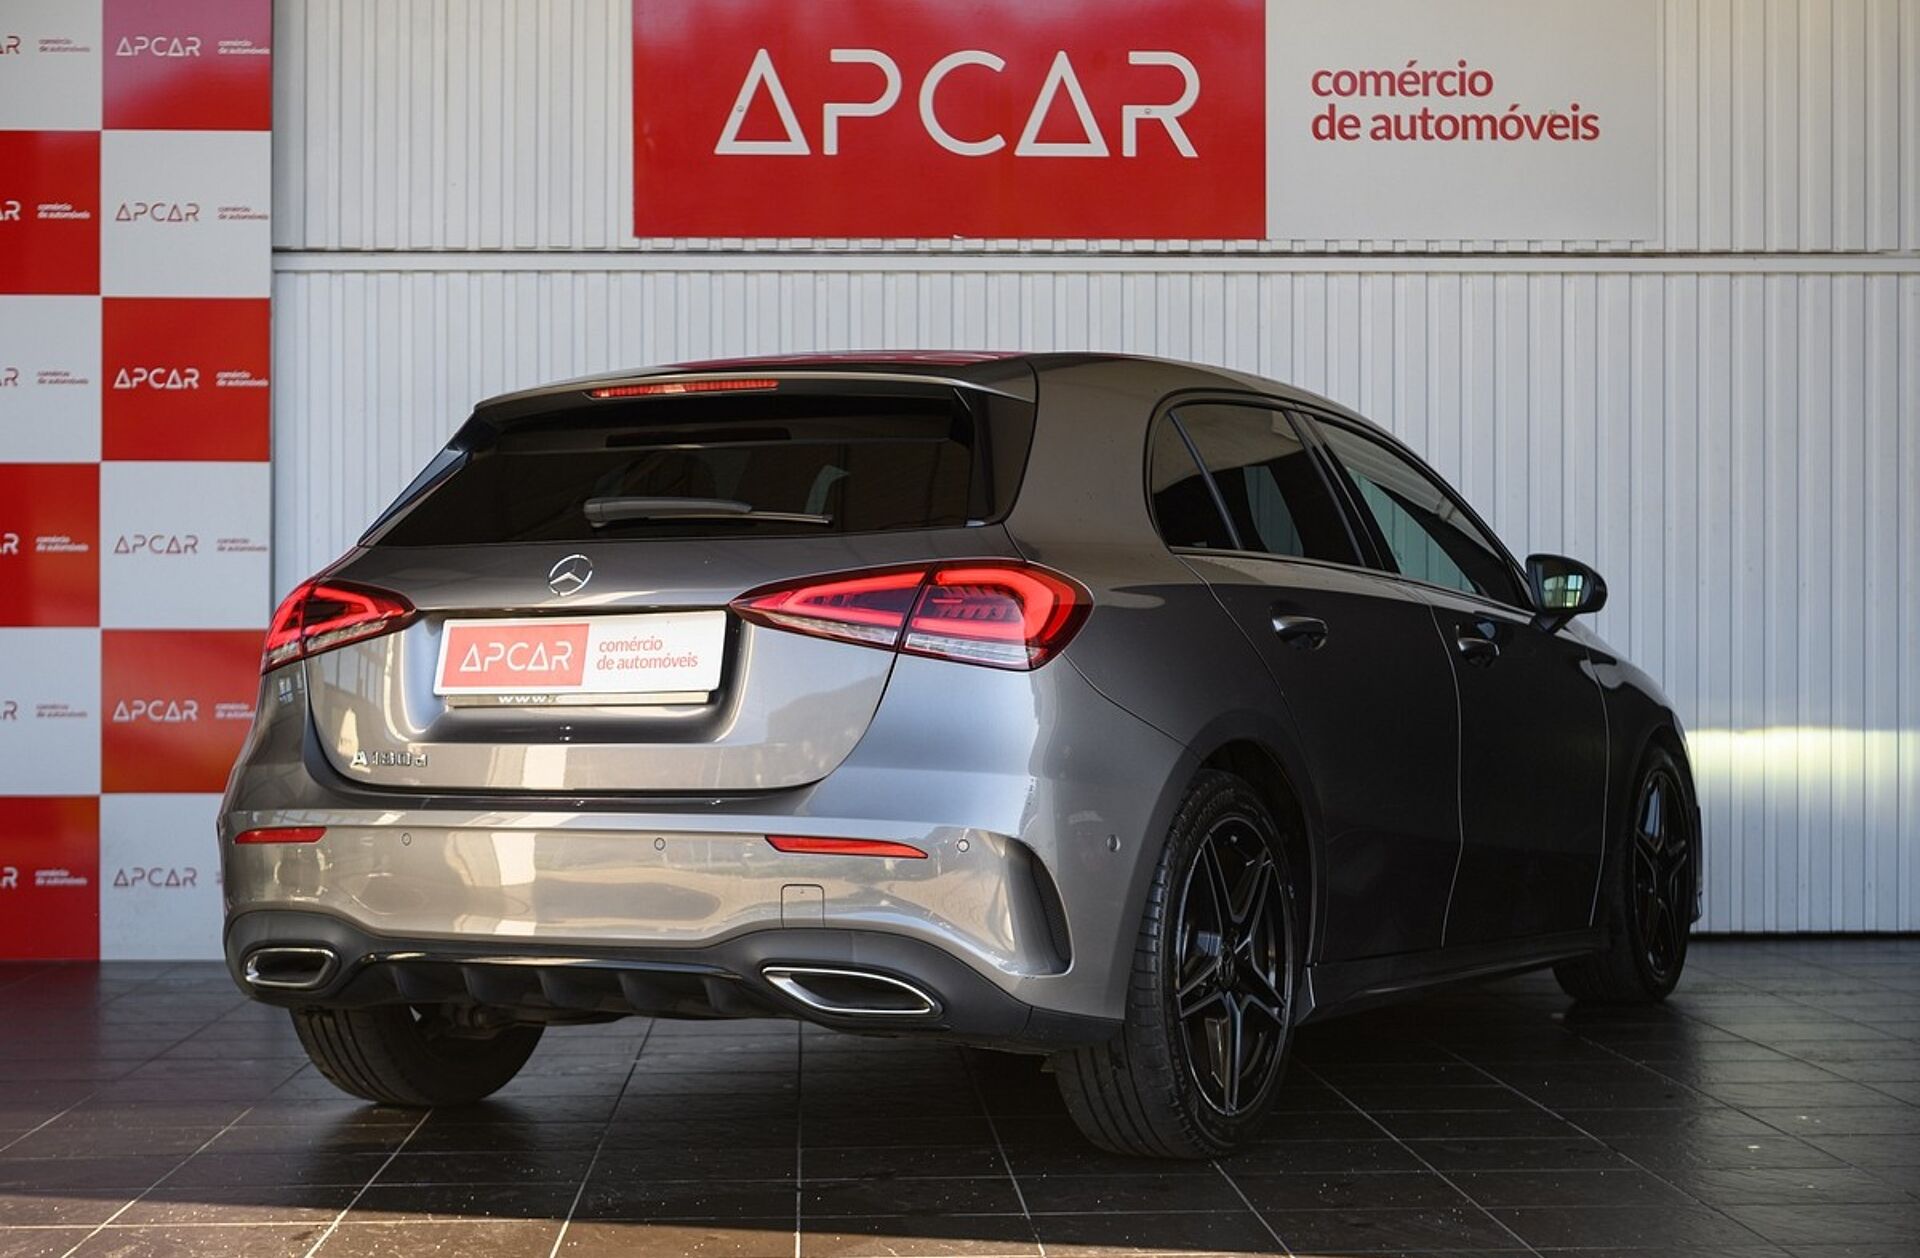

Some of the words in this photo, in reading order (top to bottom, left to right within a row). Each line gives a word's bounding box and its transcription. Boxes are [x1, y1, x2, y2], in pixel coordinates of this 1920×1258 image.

[0, 36, 21, 54] R
[116, 36, 201, 56] APCAR
[1311, 59, 1494, 98] comércio
[714, 48, 1201, 158] APCAR
[1311, 104, 1361, 141] de
[1369, 104, 1600, 141] automóveis
[0, 200, 21, 221] R
[115, 202, 200, 222] APCAR
[113, 367, 200, 390] APCAR
[114, 534, 199, 555] APCAR
[599, 635, 664, 653] comércio
[460, 640, 574, 673] APCAR
[597, 655, 613, 671] de
[616, 652, 699, 670] automóveis
[113, 700, 198, 722] APCAR
[113, 867, 197, 888] APCAR
